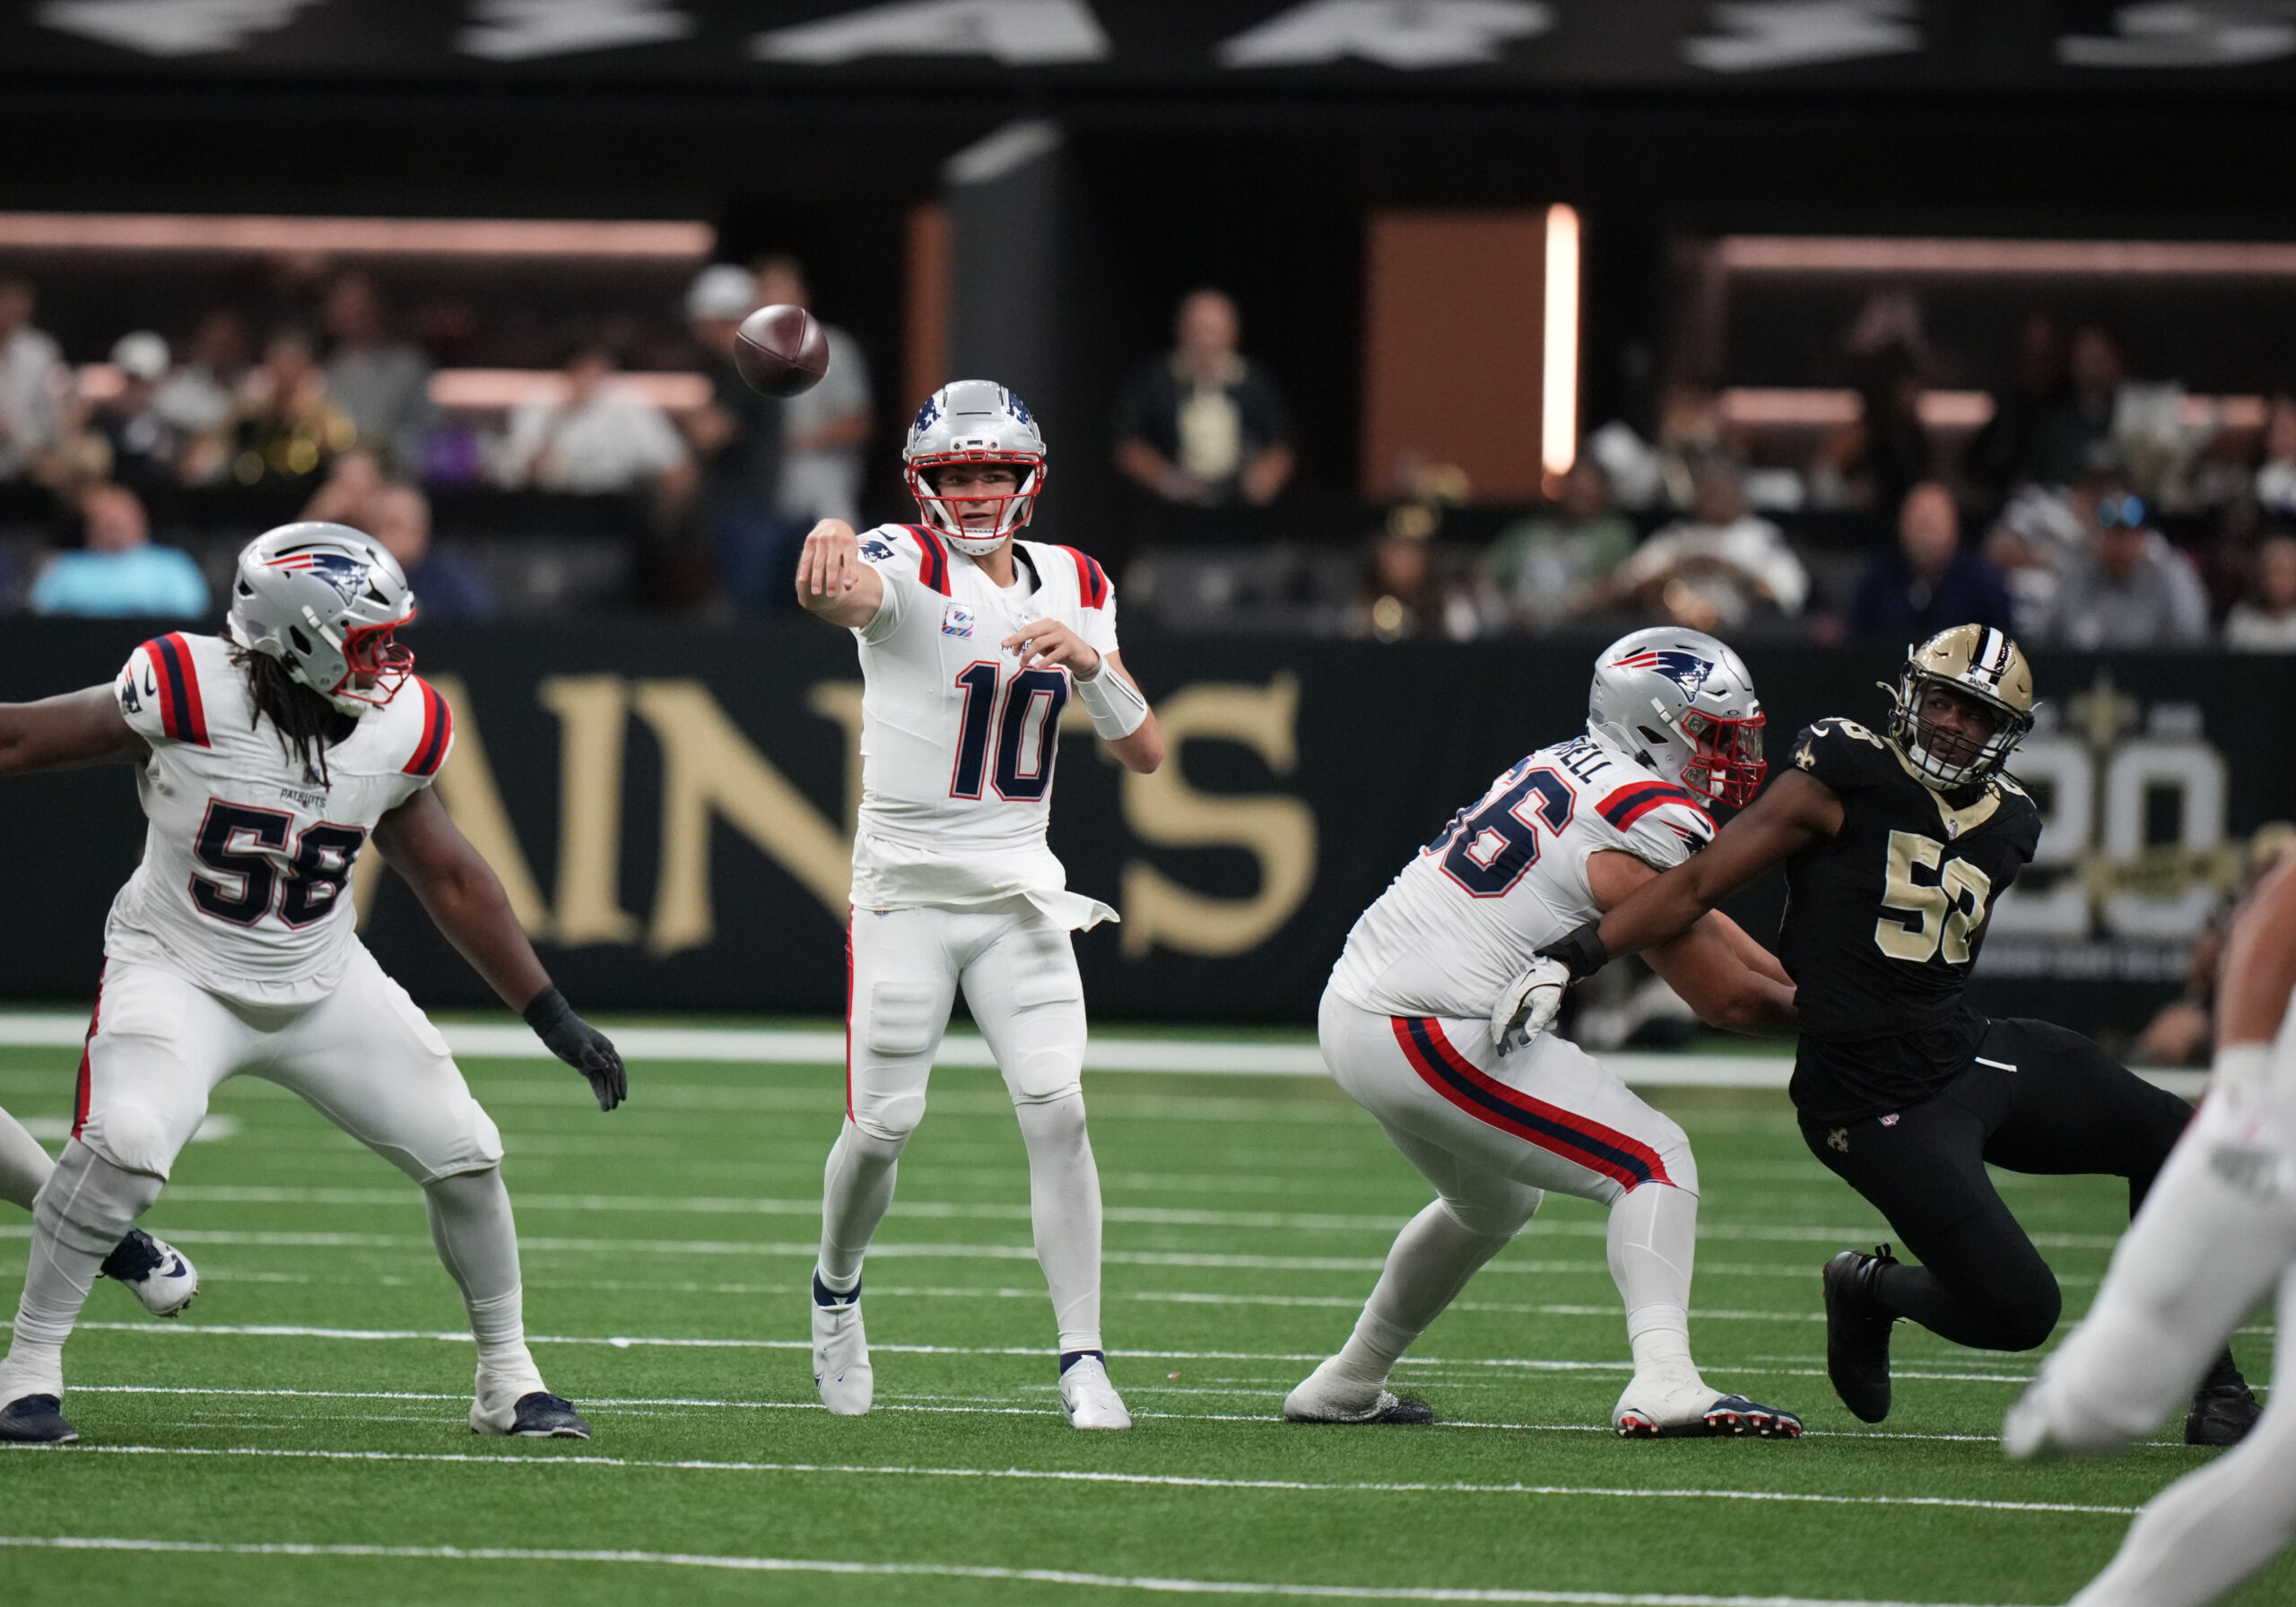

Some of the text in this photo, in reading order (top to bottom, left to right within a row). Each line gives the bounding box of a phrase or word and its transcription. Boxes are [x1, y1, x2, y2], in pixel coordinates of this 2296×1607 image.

[949, 659, 1071, 802] 10
[189, 797, 367, 930] 58
[280, 788, 326, 808] PATRIOTS
